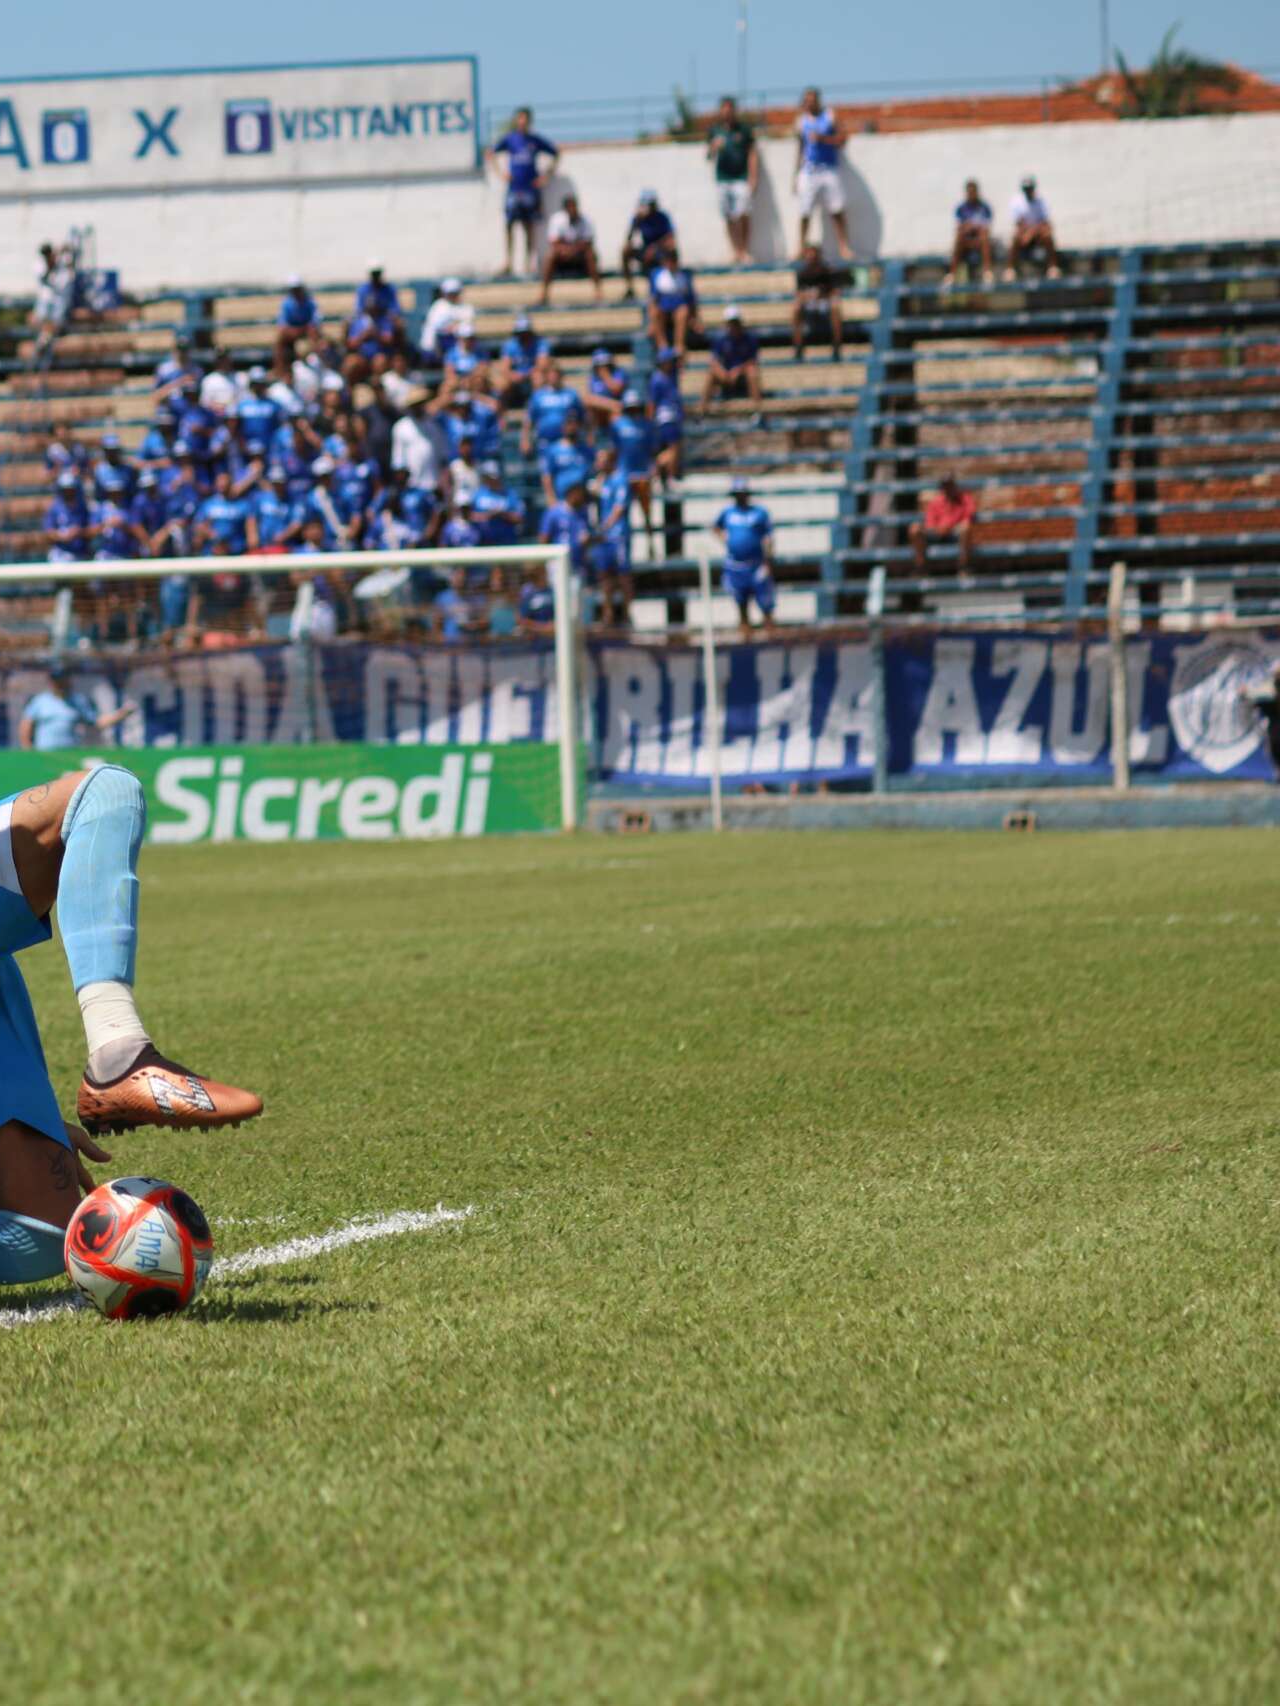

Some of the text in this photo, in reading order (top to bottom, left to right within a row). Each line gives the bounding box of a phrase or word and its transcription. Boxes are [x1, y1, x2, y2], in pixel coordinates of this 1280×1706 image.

[134, 107, 181, 158] X
[278, 99, 473, 142] VISITANTES
[915, 638, 1167, 766] AZUL
[150, 753, 495, 843] Sicredi
